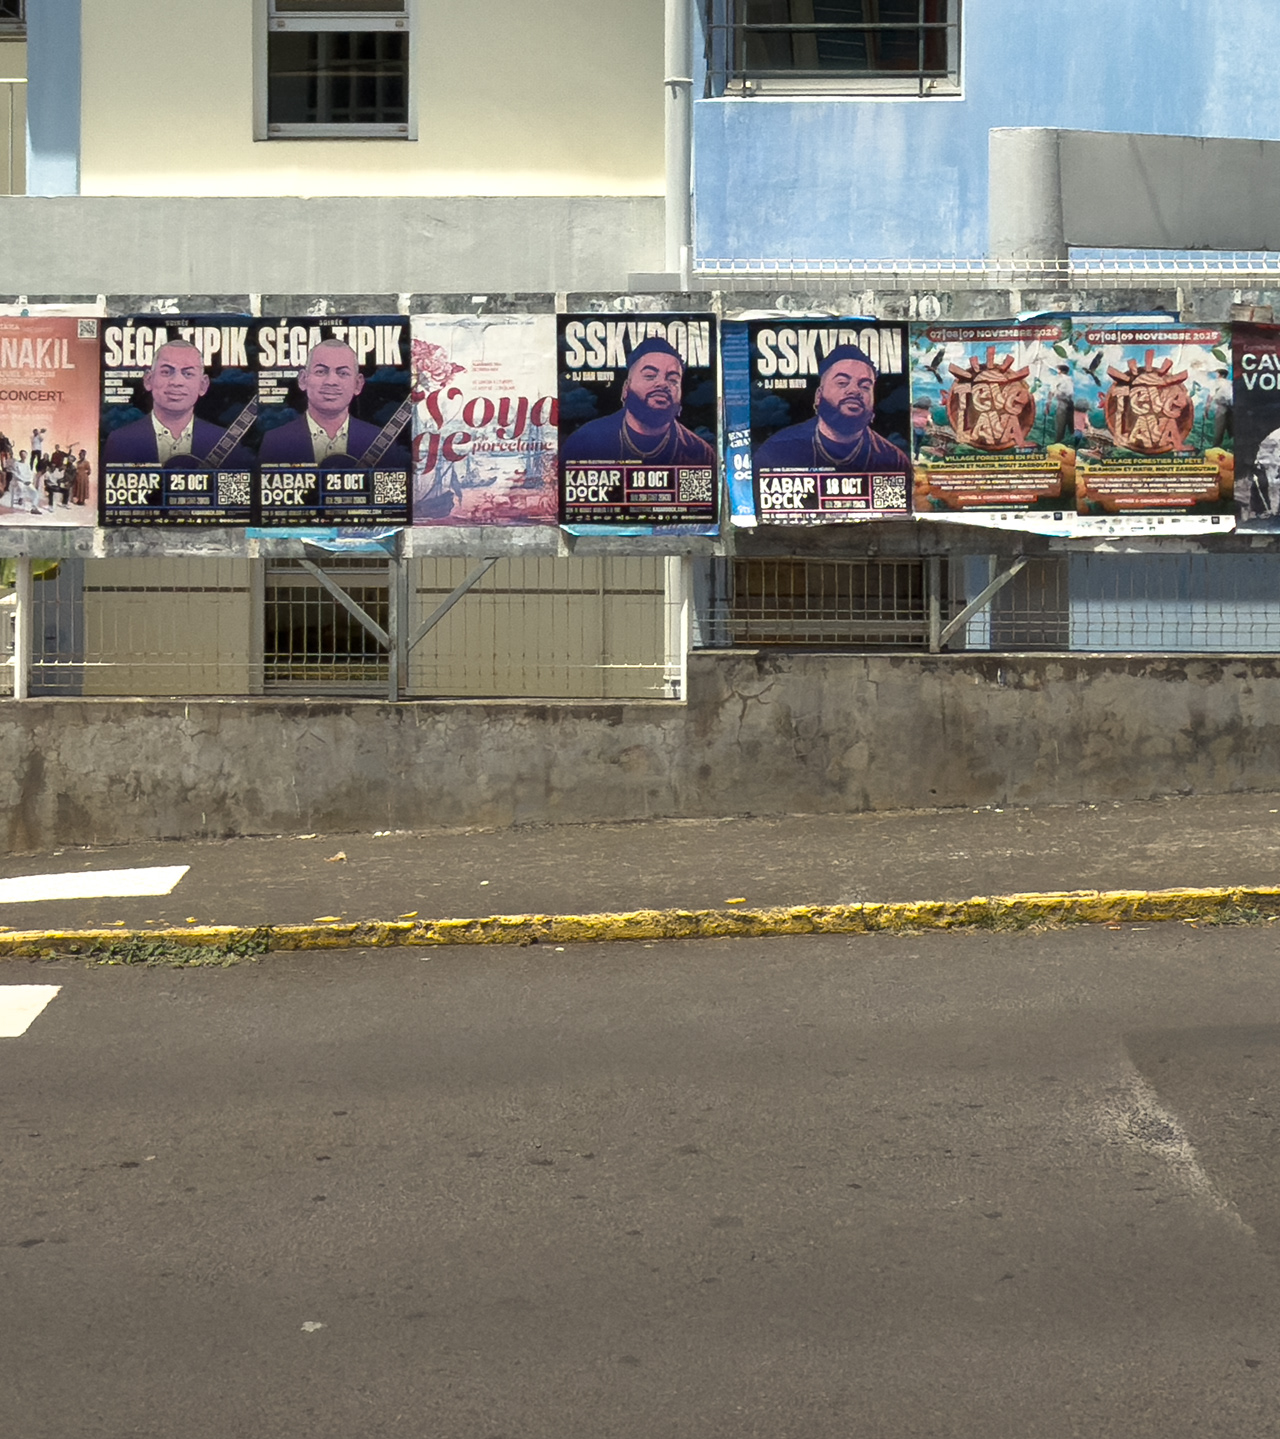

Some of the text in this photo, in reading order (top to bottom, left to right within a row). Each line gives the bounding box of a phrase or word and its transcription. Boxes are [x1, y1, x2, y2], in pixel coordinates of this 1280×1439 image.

[977, 330, 1032, 338] NOVEMBRE
[1034, 329, 1058, 337] 2025
[1193, 332, 1218, 340] 2025
[0, 390, 64, 401] CONCERT
[472, 438, 555, 455] porcelaine
[105, 473, 160, 489] KABAR
[170, 474, 209, 490] 25 OCT
[261, 473, 316, 489] KABAR
[327, 474, 365, 490] 25 OCT
[565, 470, 620, 486] KABAR
[632, 471, 669, 487] 18 OCT
[759, 477, 815, 493] KABAR
[826, 478, 862, 494] 18 OCT
